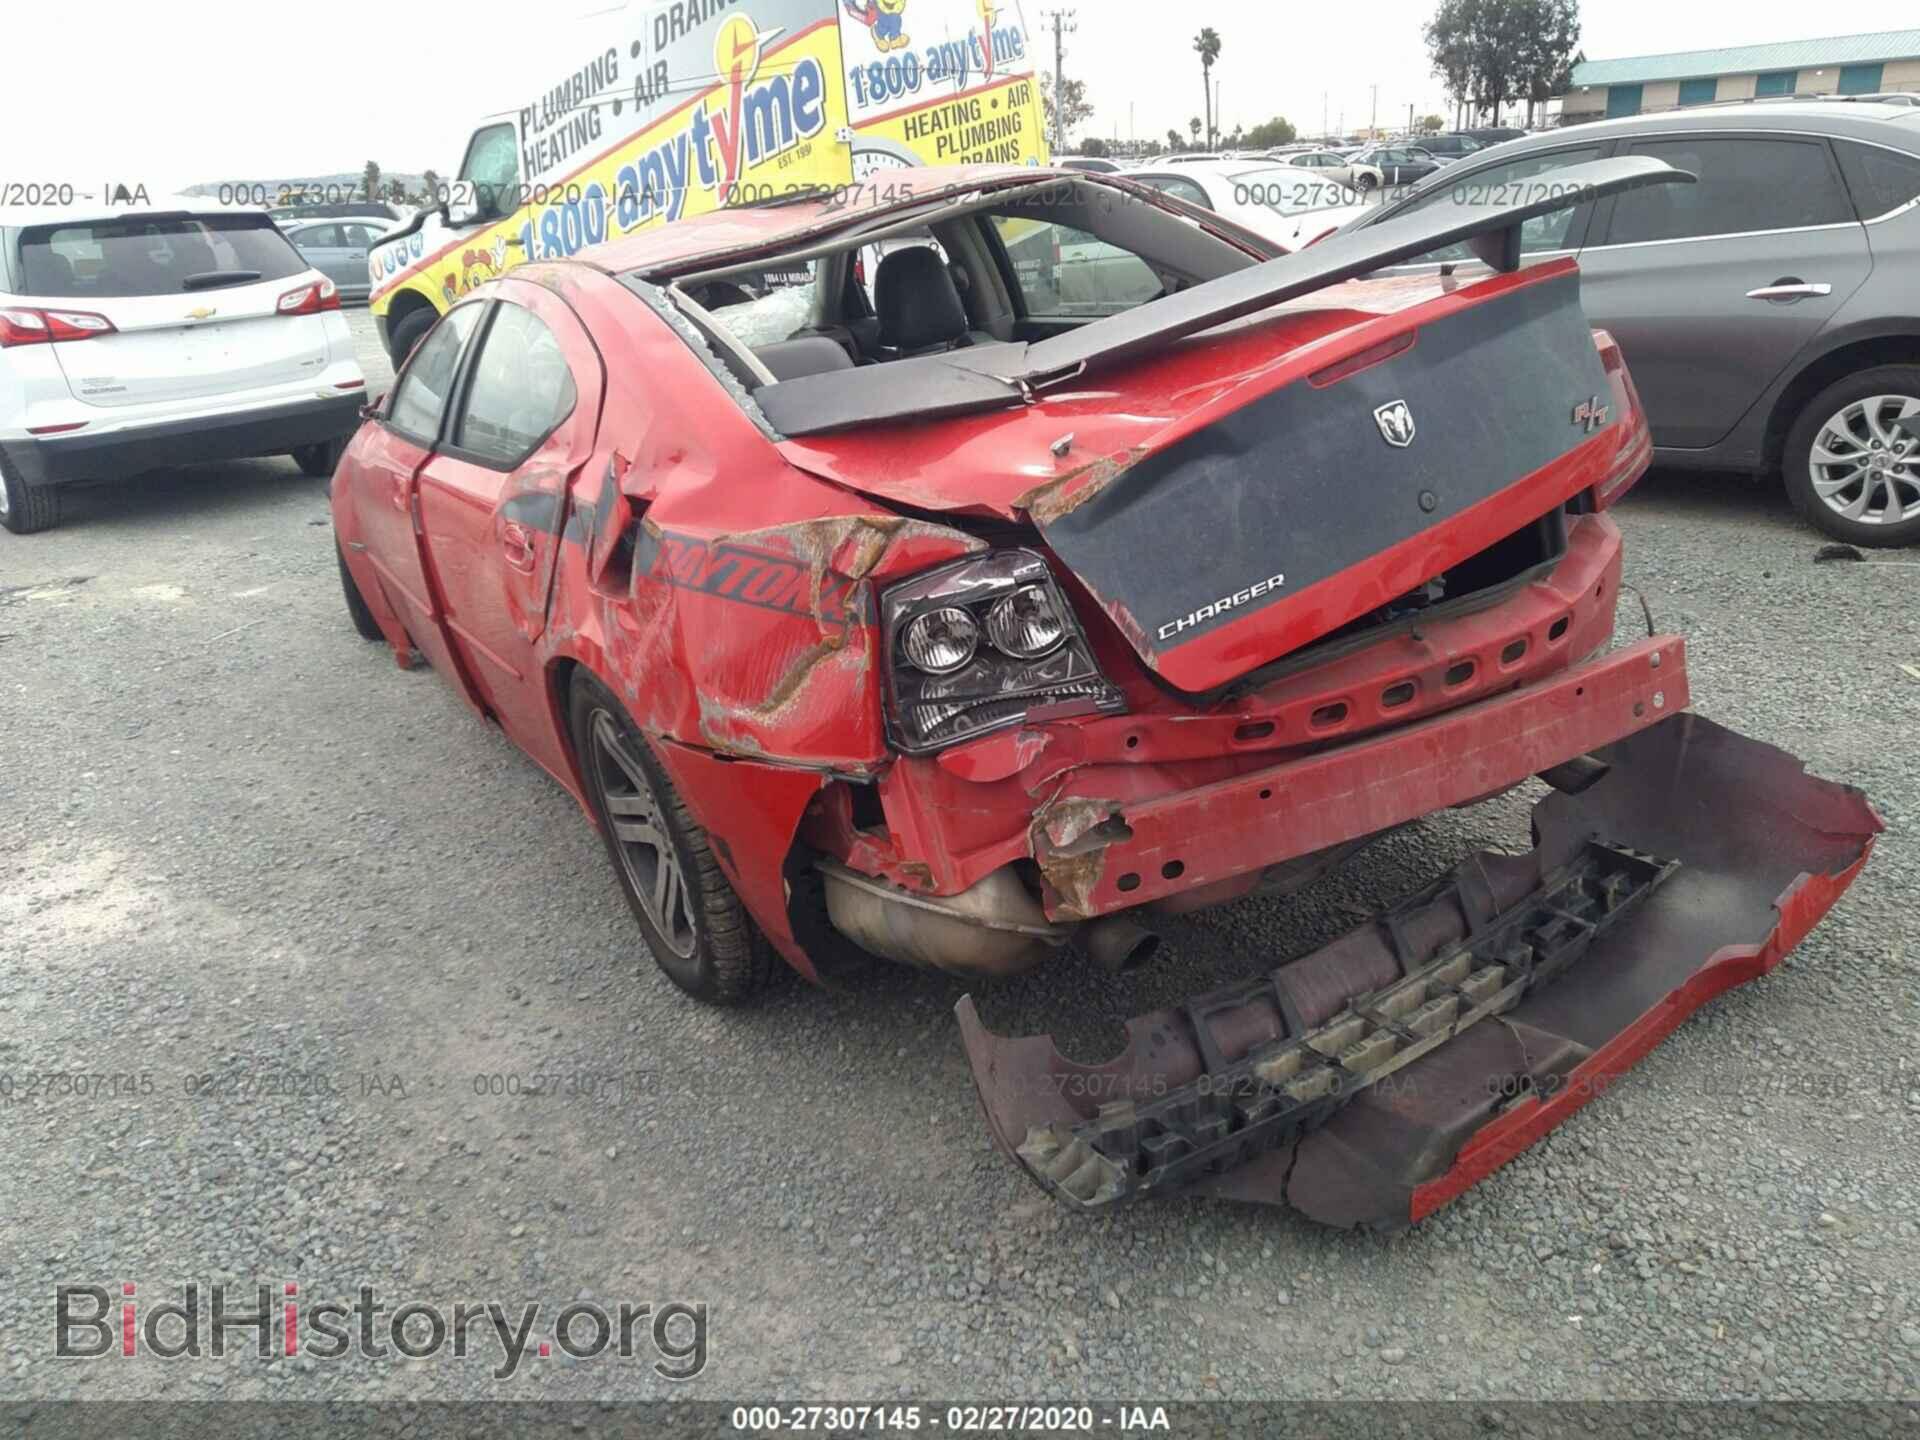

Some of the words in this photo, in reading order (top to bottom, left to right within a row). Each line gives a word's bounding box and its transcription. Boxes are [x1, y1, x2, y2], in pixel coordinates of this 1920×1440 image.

[520, 47, 619, 143] PLUMBING
[654, 0, 737, 52] DRAIN
[522, 104, 602, 181] HEATING
[635, 59, 669, 113] AIR
[904, 98, 981, 141] HEATING
[1008, 84, 1030, 110] AIR
[937, 111, 1022, 158] PLUMBING
[1574, 395, 1609, 432] R/T
[1157, 573, 1286, 641] CHARGER
